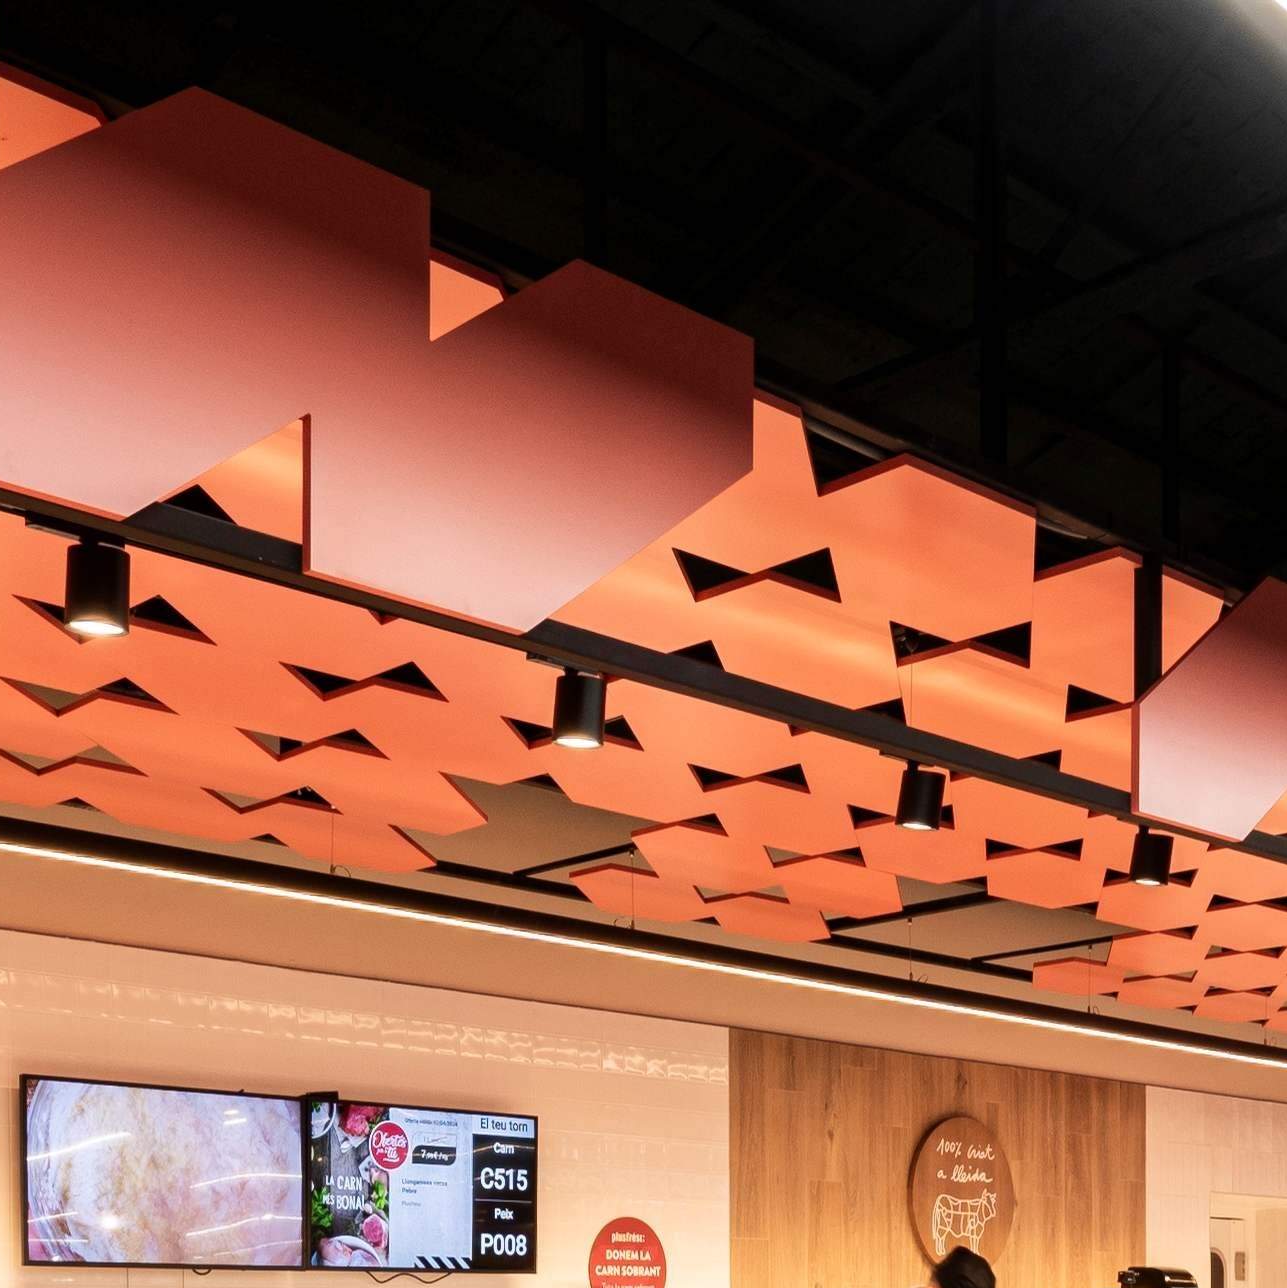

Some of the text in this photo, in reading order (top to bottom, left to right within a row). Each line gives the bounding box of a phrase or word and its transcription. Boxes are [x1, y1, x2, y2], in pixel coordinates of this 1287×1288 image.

[480, 1120, 528, 1132] El teu torn
[493, 1142, 515, 1154] Carn
[936, 1138, 962, 1159] 100%
[480, 1167, 528, 1191] C515
[937, 1164, 993, 1183] a lleida
[325, 1175, 362, 1191] LA CARN
[494, 1208, 514, 1220] Peix
[480, 1233, 527, 1256] P008
[605, 1249, 651, 1261] DONEM LA
[595, 1265, 661, 1277] CARN SOBRANT
